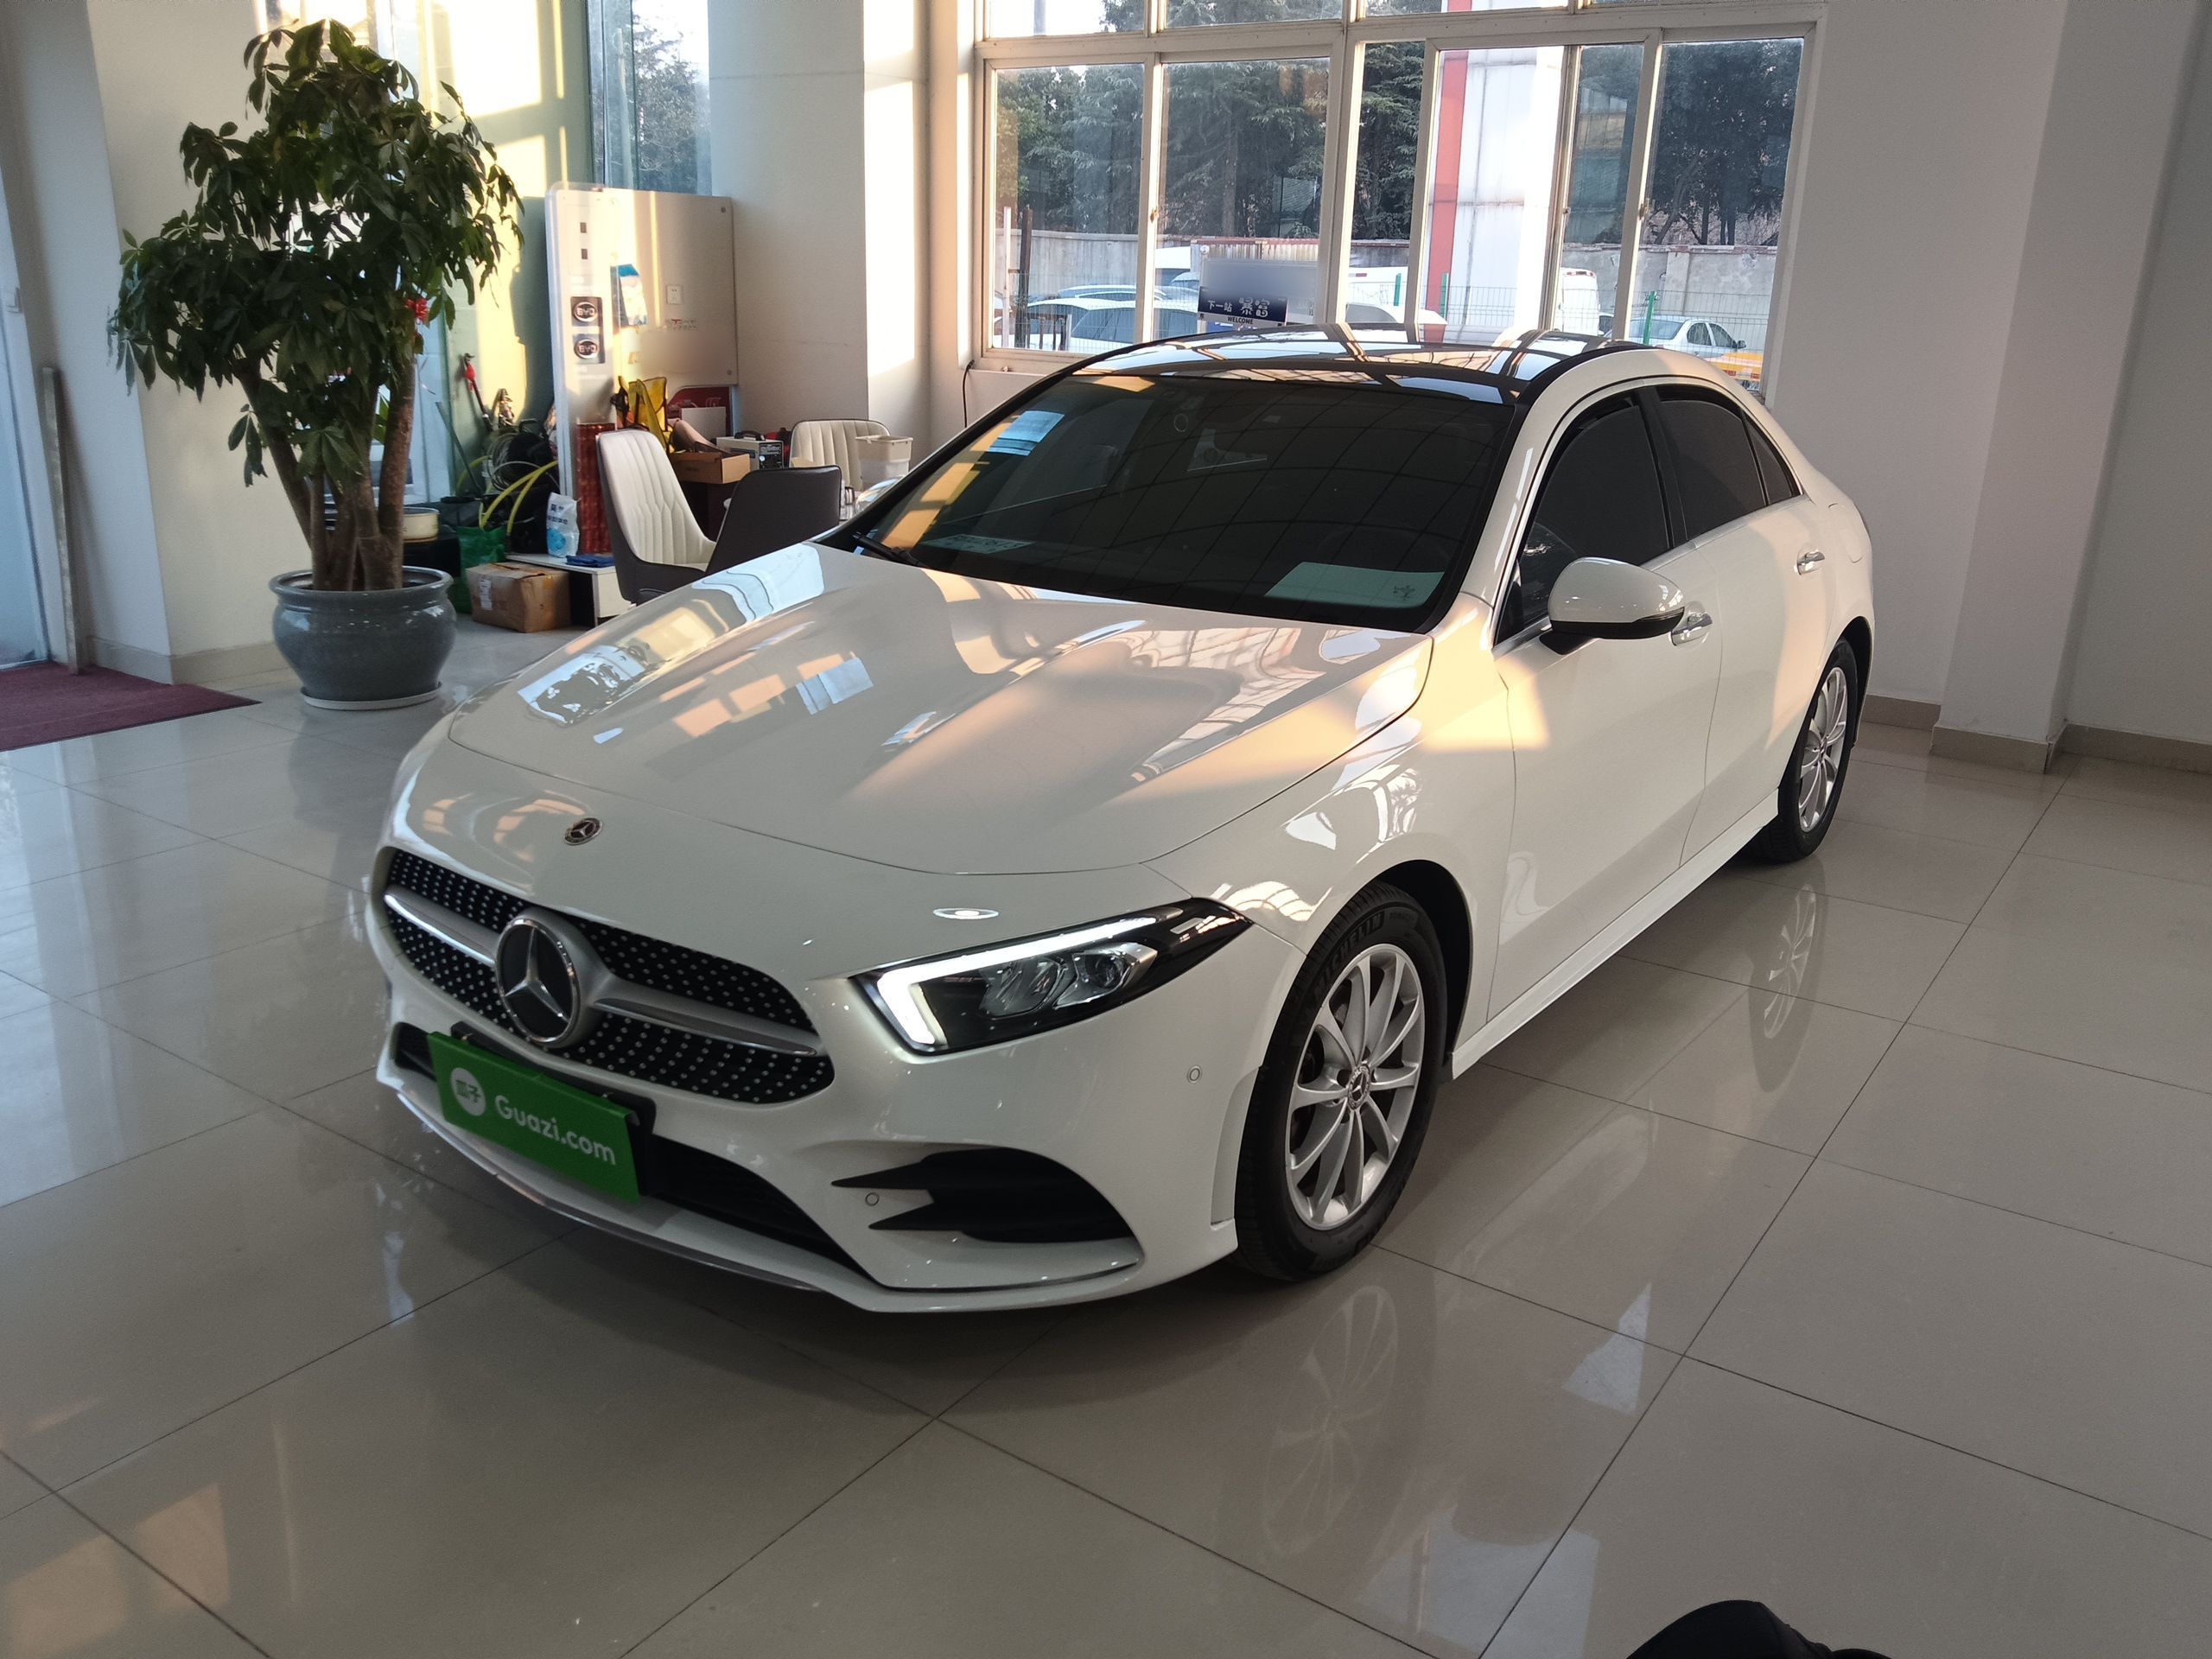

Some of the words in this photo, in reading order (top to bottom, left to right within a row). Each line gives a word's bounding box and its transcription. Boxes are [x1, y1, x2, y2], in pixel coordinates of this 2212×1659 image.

[576, 307, 595, 316] BYD
[1207, 300, 1233, 313] 下一站
[1227, 315, 1254, 325] WELCOME
[578, 344, 597, 353] BYD
[1314, 911, 1383, 1000] MICHELIN
[494, 1094, 617, 1166] Guazi.com
